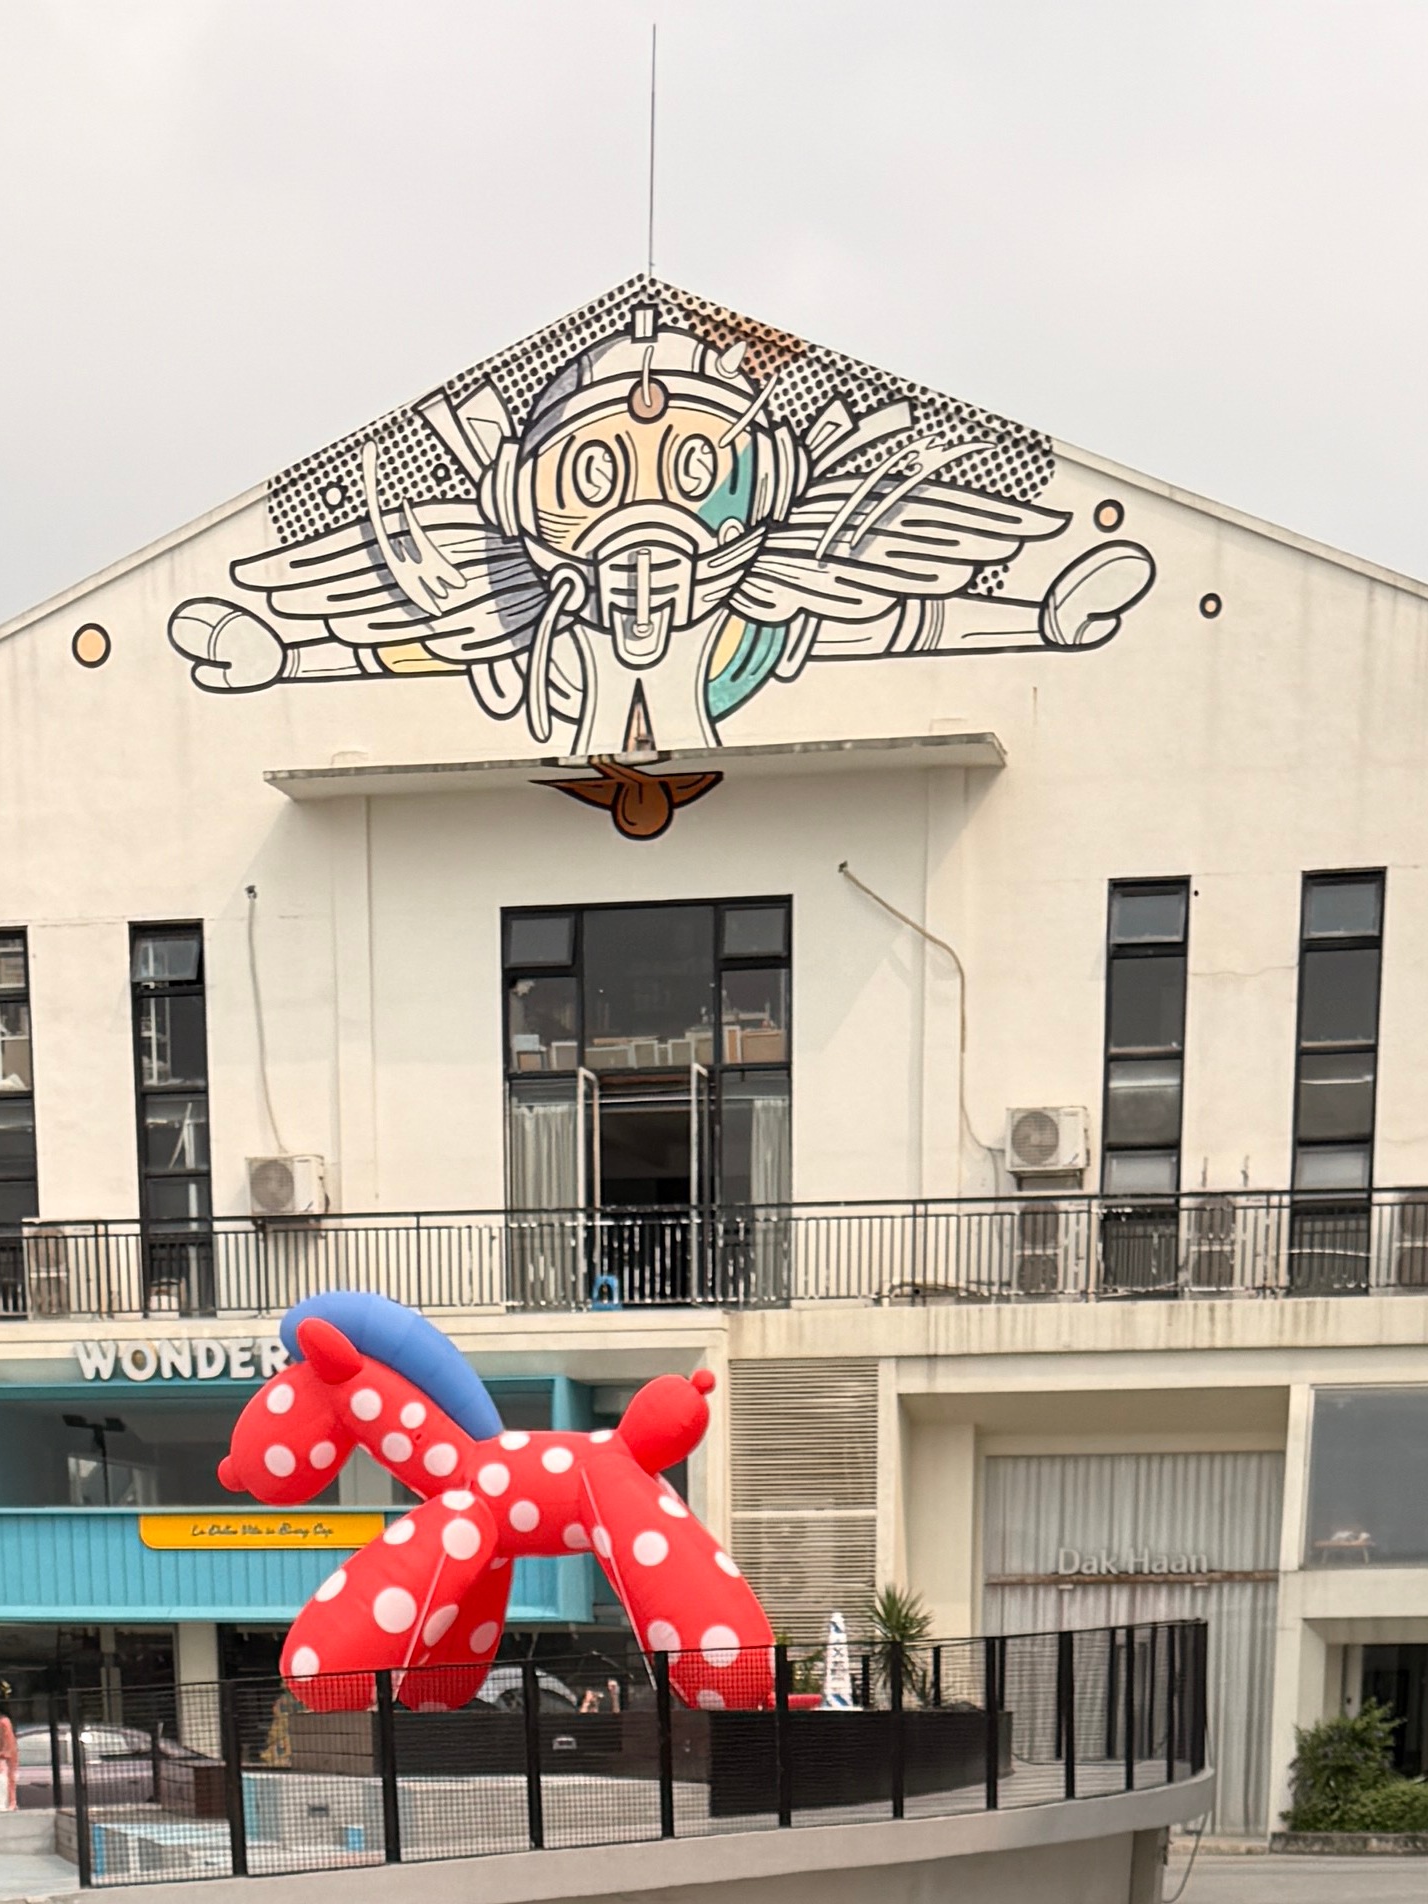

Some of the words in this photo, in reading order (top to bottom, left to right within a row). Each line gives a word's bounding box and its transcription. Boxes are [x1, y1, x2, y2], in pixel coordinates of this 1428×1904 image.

[75, 1338, 289, 1382] WONDER
[1058, 1548, 1119, 1575] Dak
[1127, 1548, 1208, 1574] Haan
